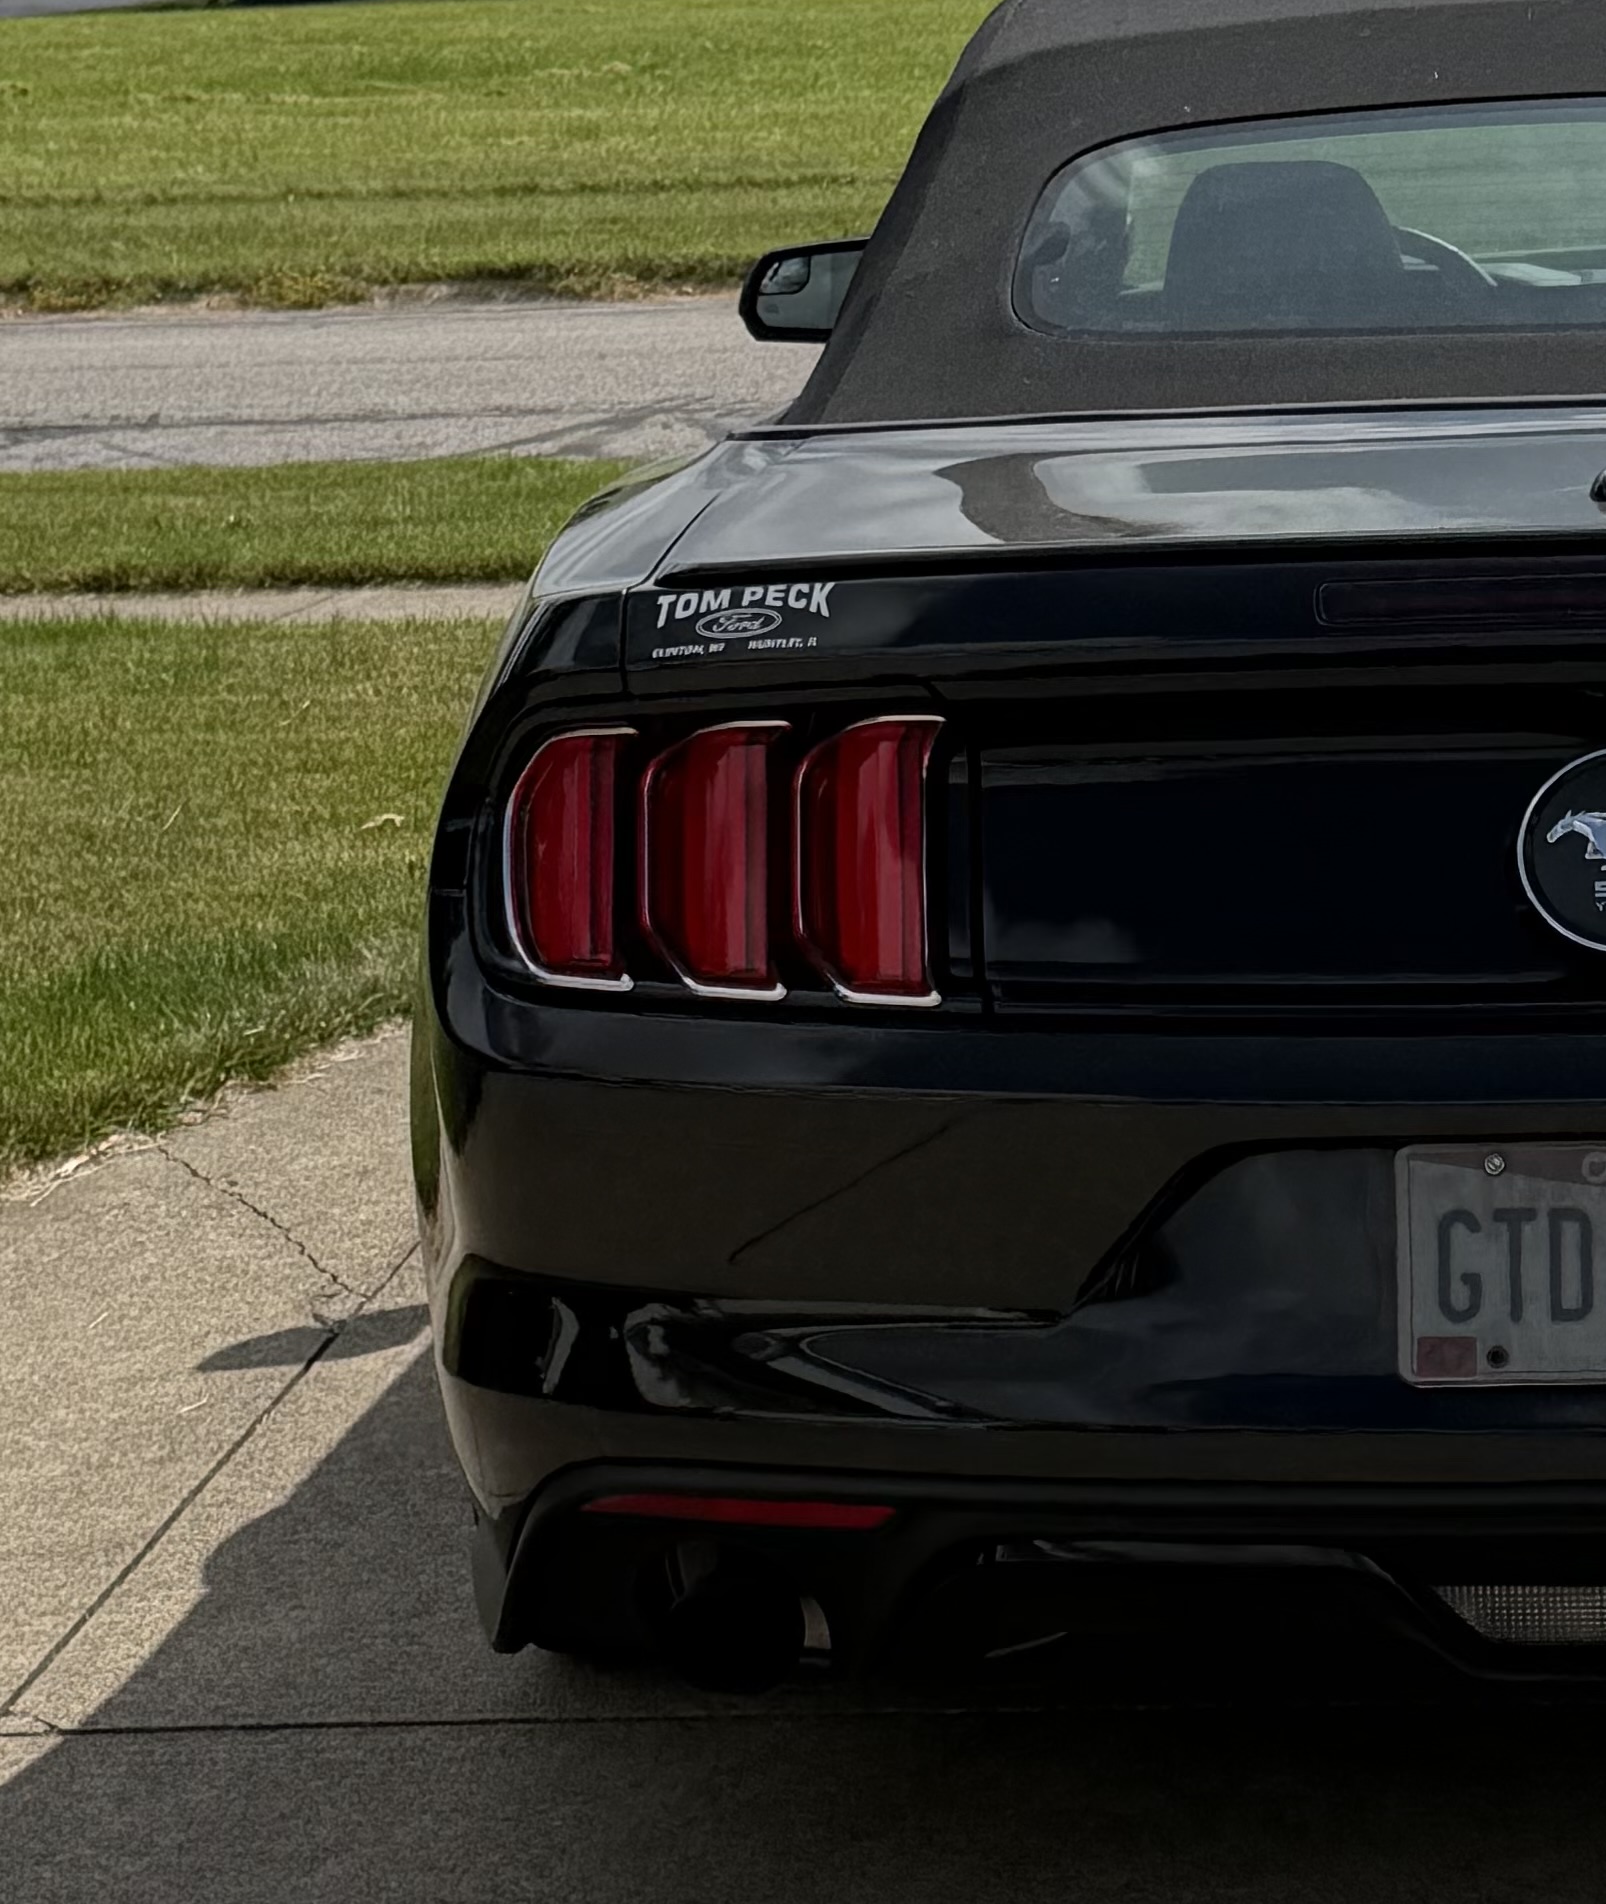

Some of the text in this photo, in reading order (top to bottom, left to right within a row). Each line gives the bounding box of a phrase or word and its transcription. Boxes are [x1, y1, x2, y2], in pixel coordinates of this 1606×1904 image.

[656, 582, 836, 629] TOM PECK
[712, 613, 766, 632] Ford
[1437, 1207, 1594, 1324] GTD
